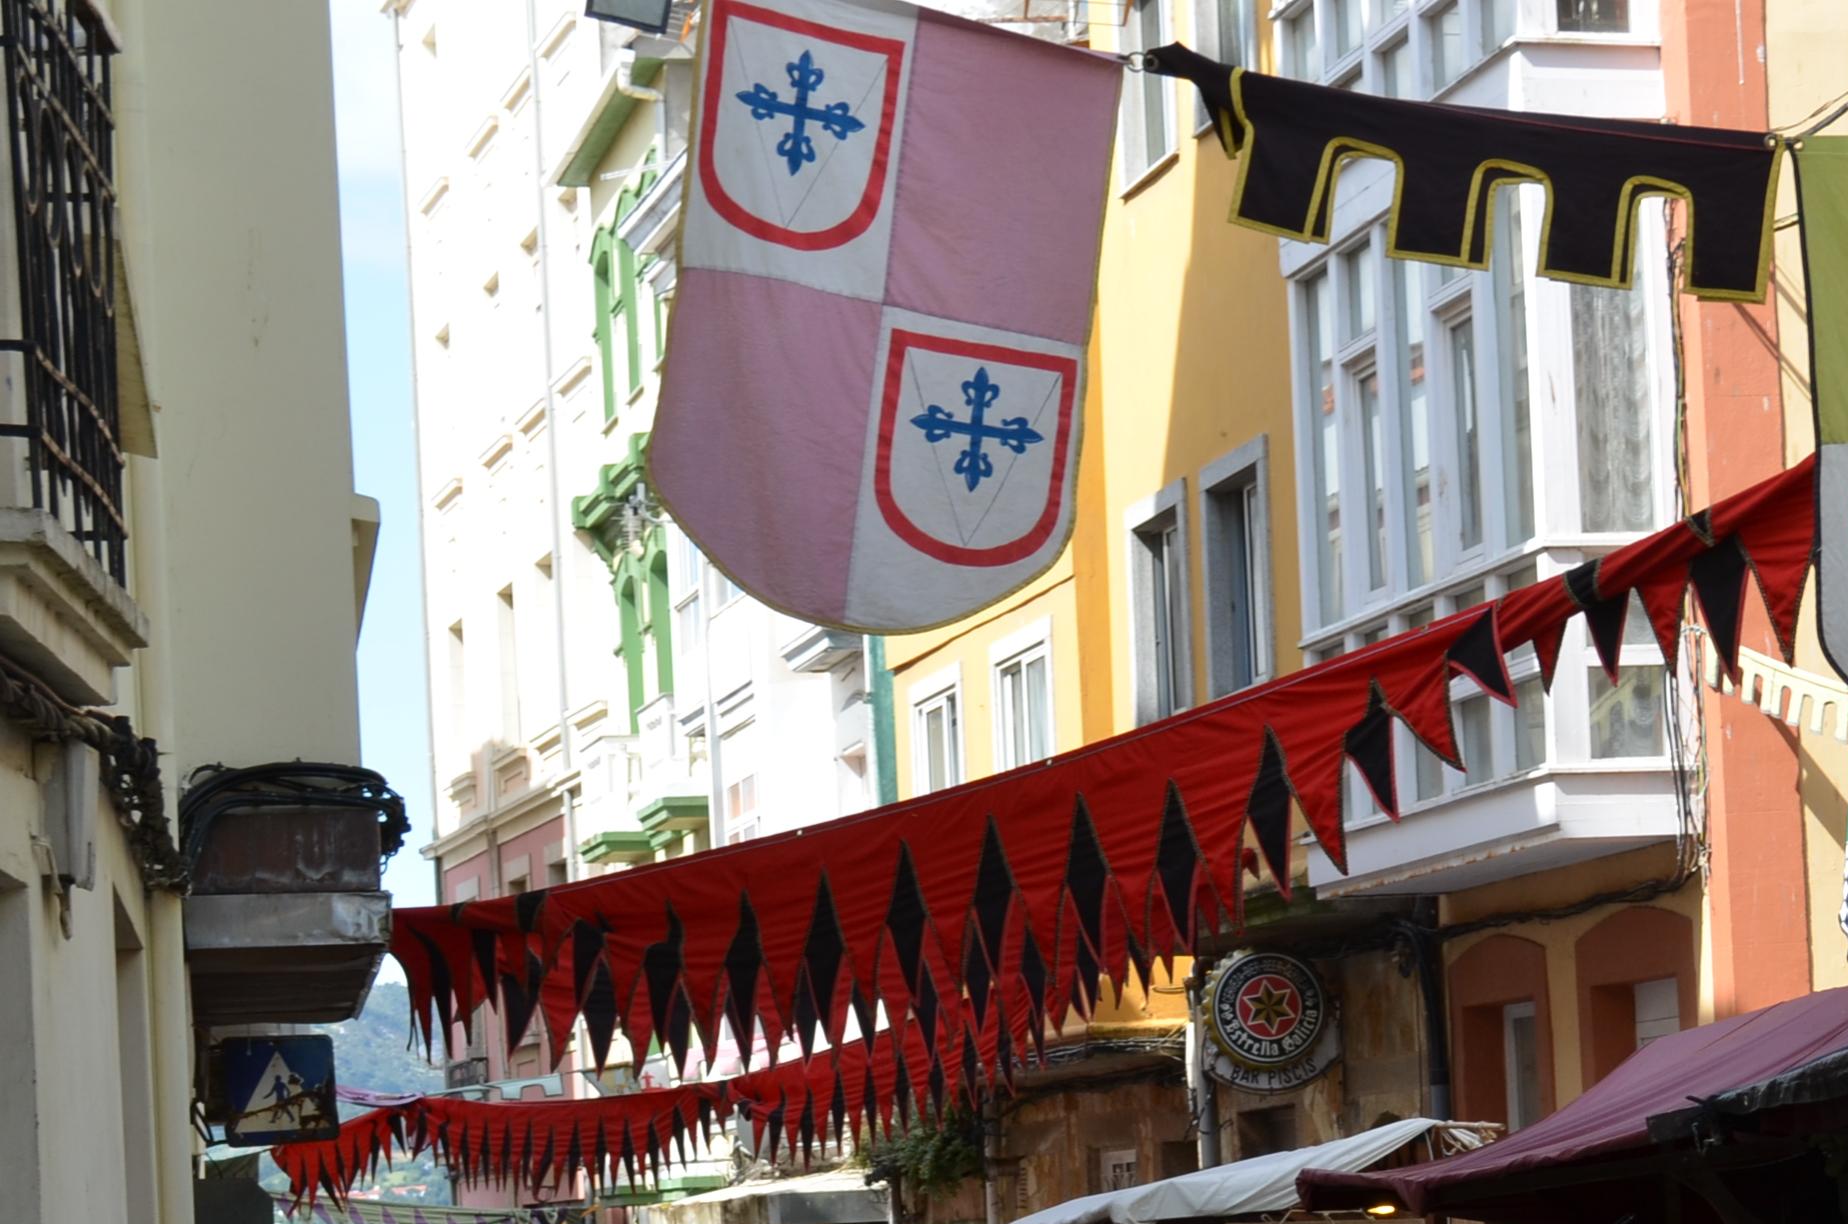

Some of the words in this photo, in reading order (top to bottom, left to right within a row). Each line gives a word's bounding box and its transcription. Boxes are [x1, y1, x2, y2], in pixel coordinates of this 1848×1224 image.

[1224, 1018, 1279, 1056] Estrella
[1281, 1009, 1318, 1054] Galicia
[1230, 1066, 1259, 1084] BAR
[1268, 1058, 1317, 1085] PISCIS
